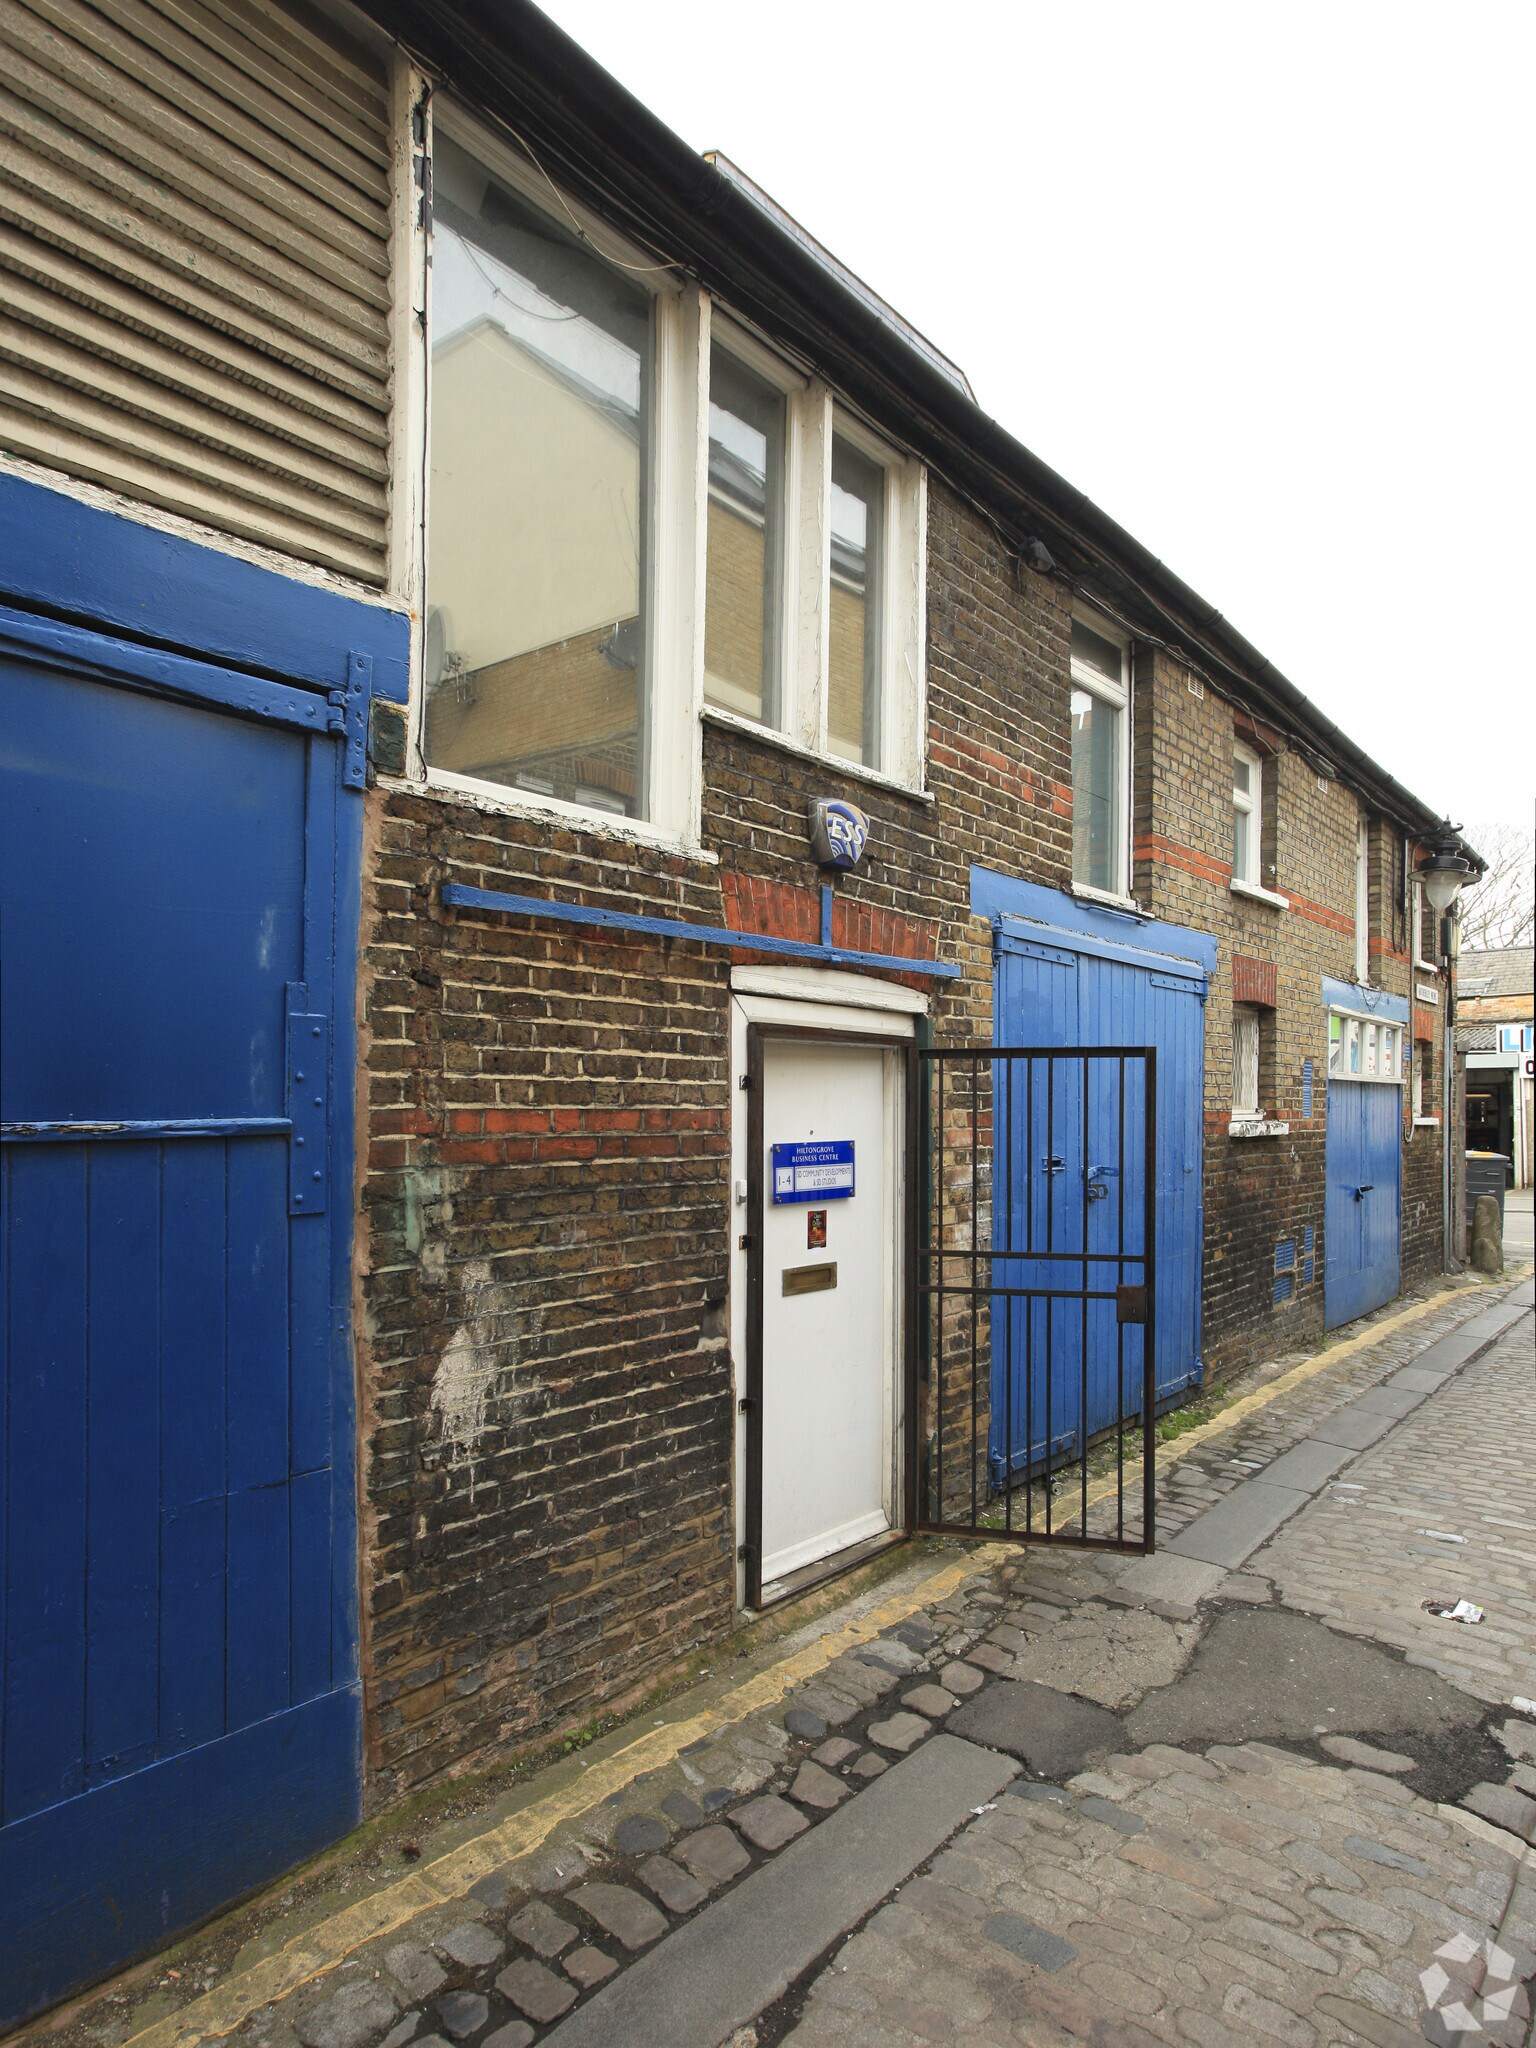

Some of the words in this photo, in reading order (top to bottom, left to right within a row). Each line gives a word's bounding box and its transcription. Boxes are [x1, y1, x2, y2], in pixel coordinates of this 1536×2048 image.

[832, 816, 864, 845] ESS
[802, 1169, 824, 1178] COMMUNITY
[825, 1167, 852, 1176] DEVELOPMENTS
[821, 1177, 837, 1186] STUDIOS
